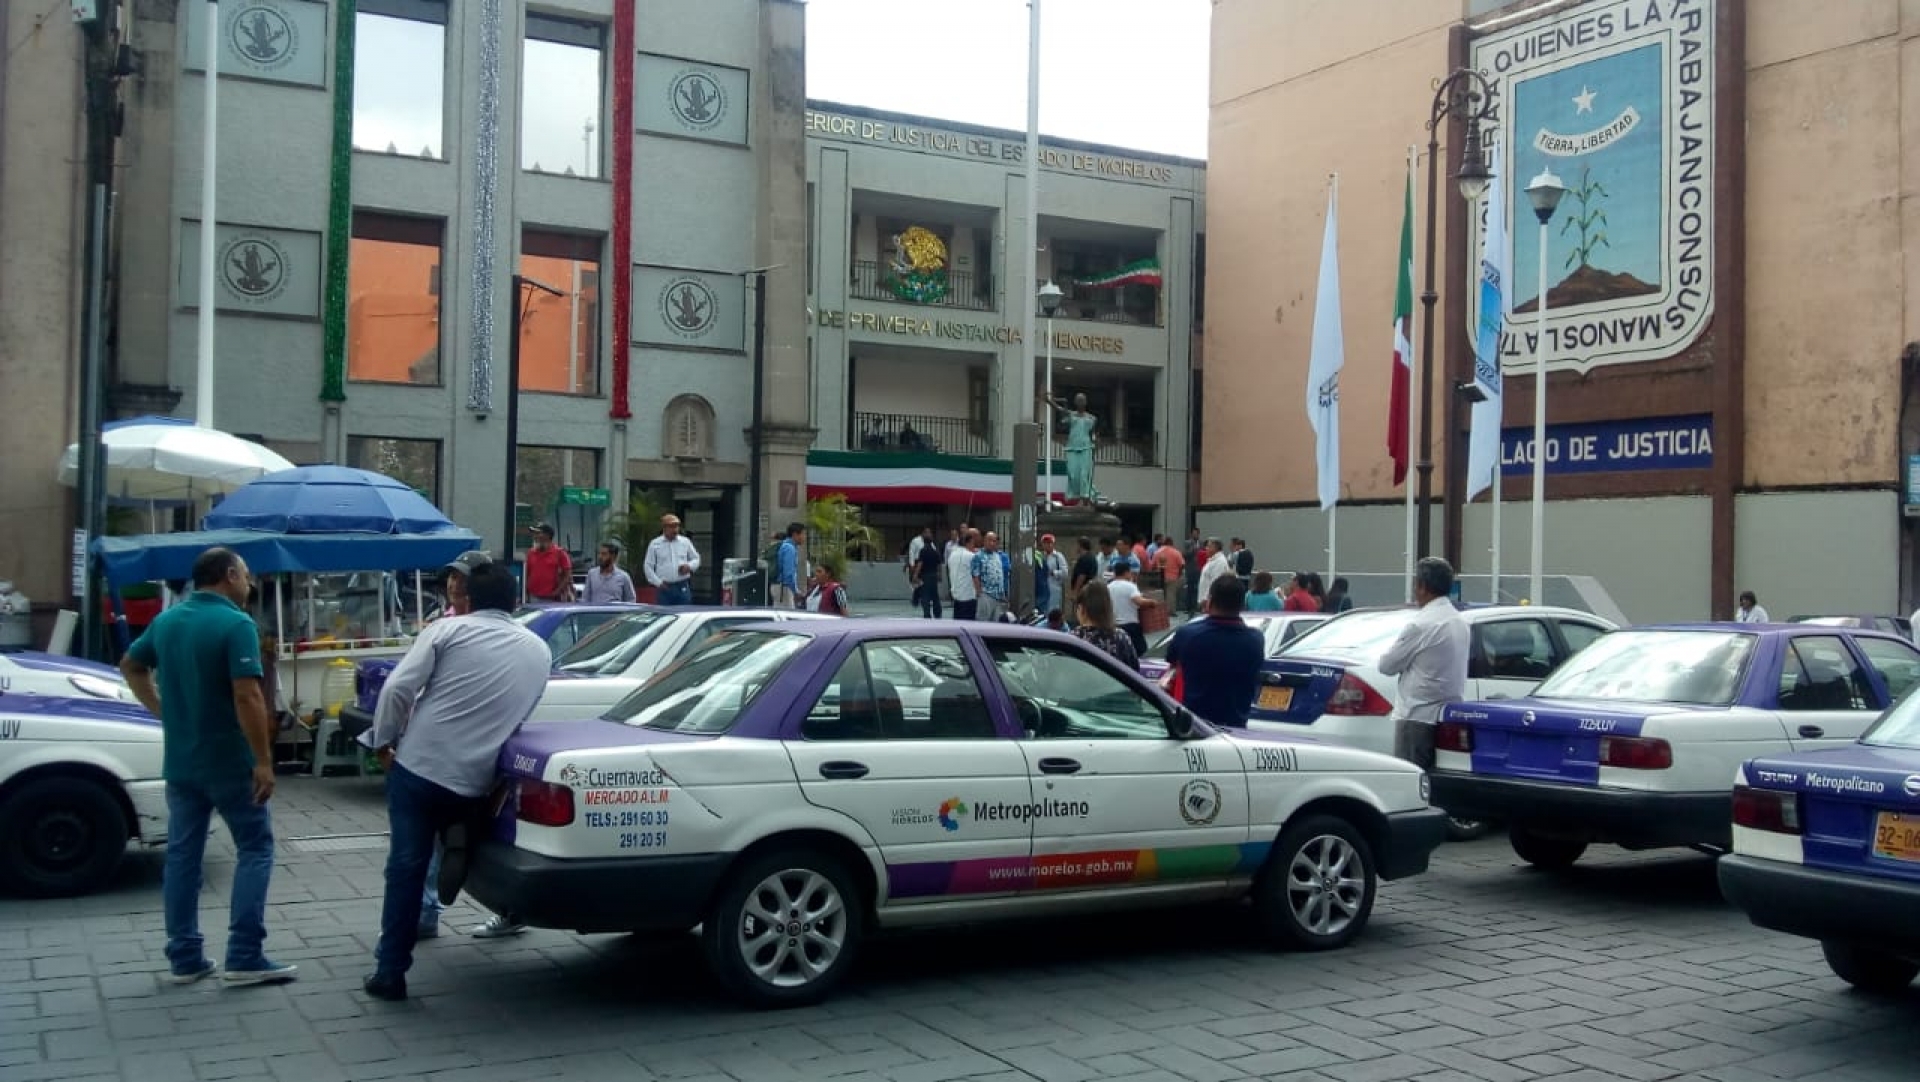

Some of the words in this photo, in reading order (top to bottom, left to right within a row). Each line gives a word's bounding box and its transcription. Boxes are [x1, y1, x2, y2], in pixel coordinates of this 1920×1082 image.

[1494, 13, 1615, 74] QUIENES
[1624, 0, 1663, 32] LA
[1581, 115, 1633, 151] LIBERTAD
[860, 120, 885, 141] DE
[888, 125, 961, 151] JUSTICIA
[965, 137, 998, 159] DEL
[1001, 143, 1068, 170] ESADO
[1071, 154, 1094, 172] DE
[1097, 156, 1174, 182] MORELOS
[818, 308, 845, 328] DE
[850, 311, 932, 337] PRIMERA
[935, 319, 1023, 346] INSTANCIA
[1500, 438, 1560, 465] LACO
[1568, 435, 1598, 462] DE
[1608, 427, 1714, 459] JUSTICIA
[1183, 747, 1209, 772] TAXI
[588, 766, 665, 787] Cuernavaca
[1805, 771, 1885, 793] Metropolitano
[584, 790, 637, 805] MERCADO
[974, 797, 1090, 823] Metropolitano
[620, 811, 639, 826] 291
[641, 811, 653, 826] 60
[656, 810, 669, 825] 30
[620, 833, 639, 848] 291
[641, 833, 653, 848] 20
[655, 831, 667, 847] 51
[988, 859, 1134, 880] www.morelos.gob.mx
